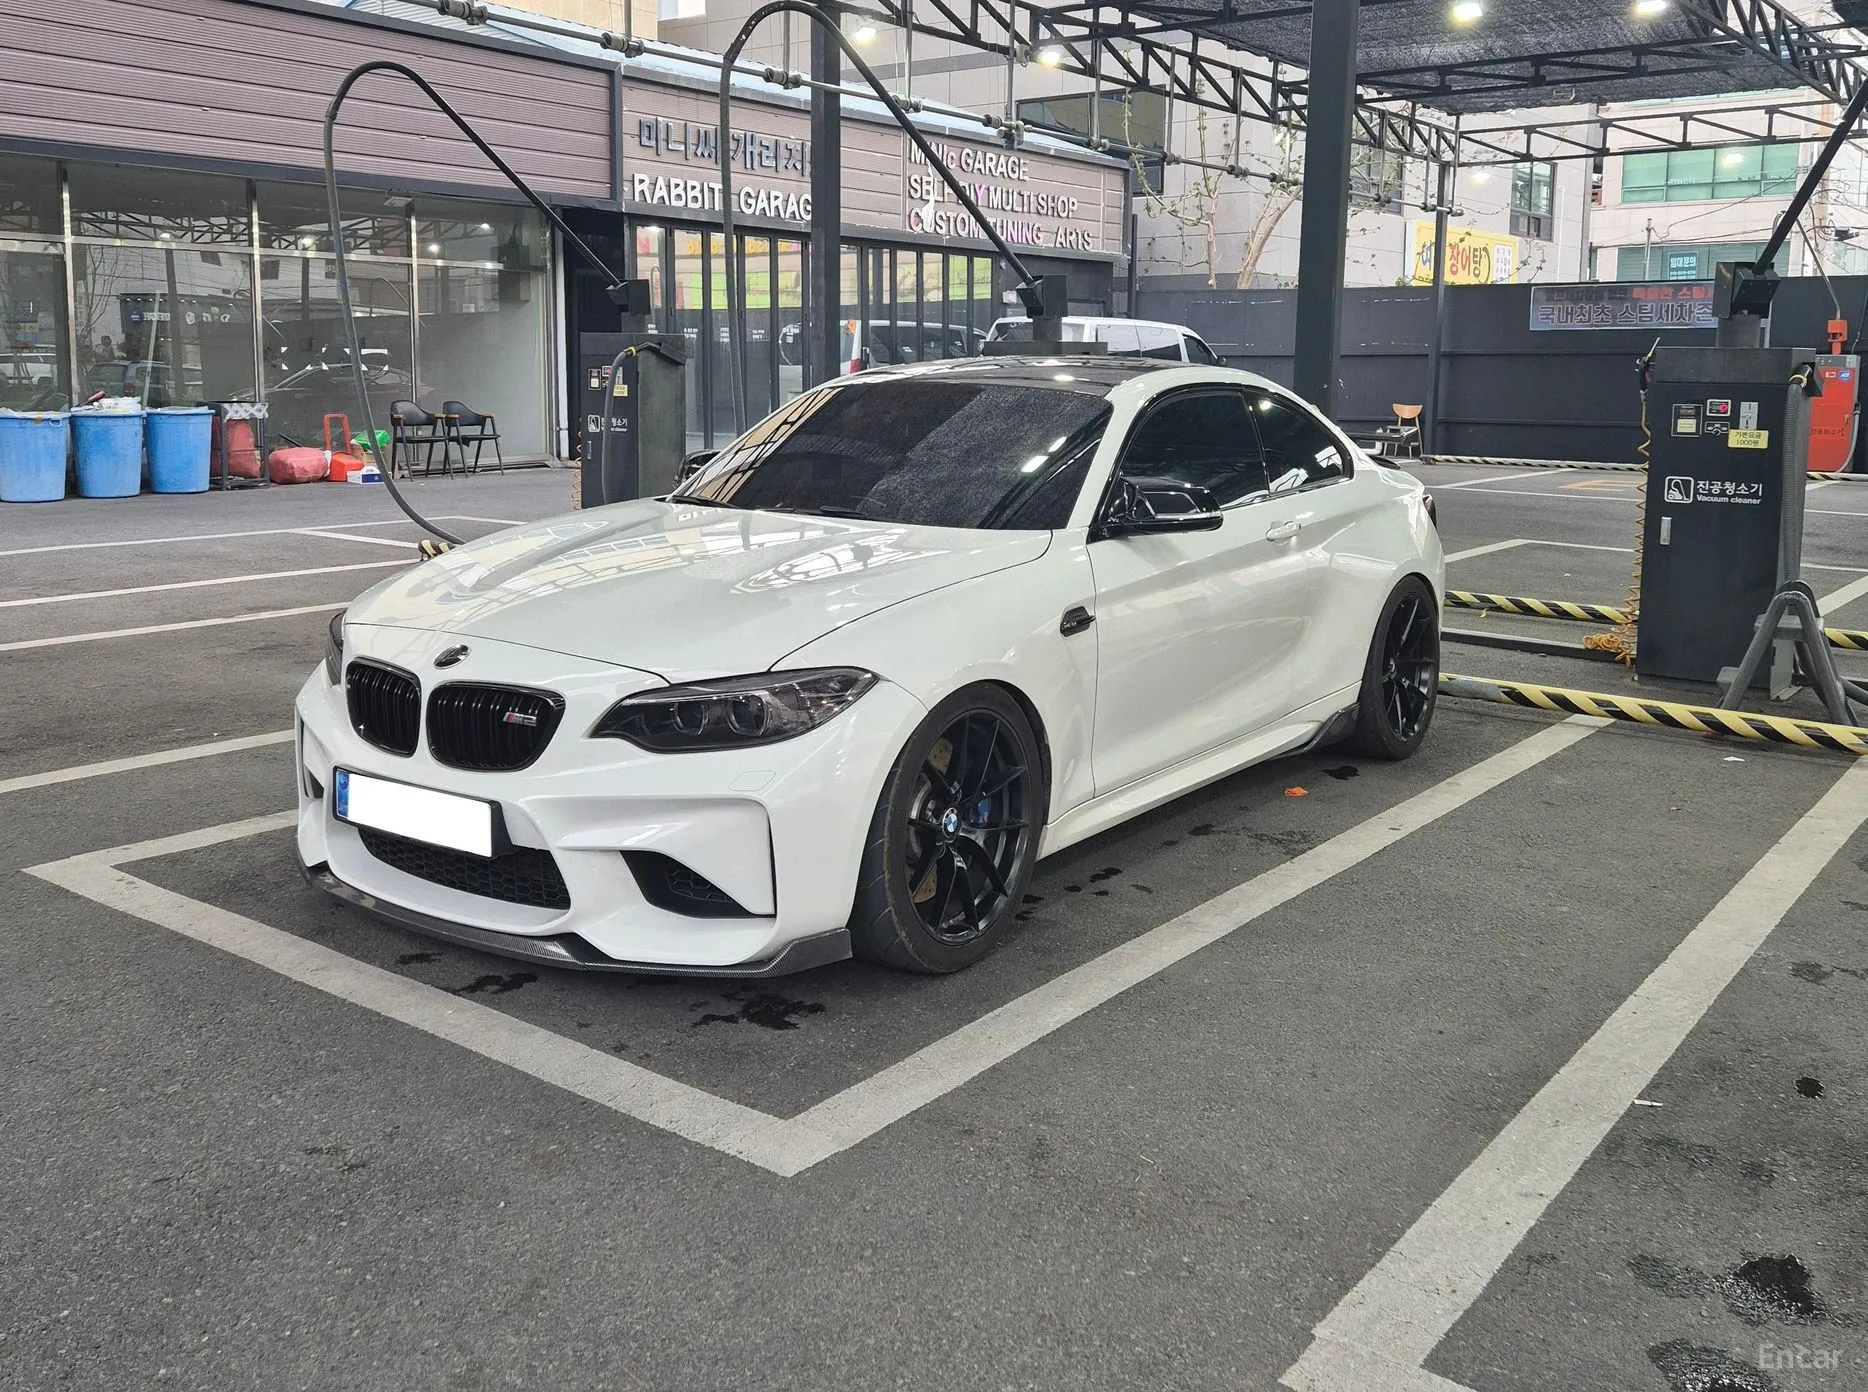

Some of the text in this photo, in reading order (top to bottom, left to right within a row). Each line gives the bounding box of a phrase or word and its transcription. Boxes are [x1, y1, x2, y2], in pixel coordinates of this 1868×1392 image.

[960, 147, 1029, 181] GARAGE
[633, 173, 723, 211] RABBIT
[988, 186, 1034, 213] MULTI
[1037, 192, 1079, 218] SHOP
[1055, 226, 1093, 250] ARTS
[1449, 242, 1482, 278] 장어탕
[1670, 256, 1697, 268] 임대문의
[1539, 303, 1612, 325] 국내최초
[1735, 431, 1762, 439] 기본요금
[1736, 439, 1760, 447] 1000원
[1696, 480, 1763, 497] 진공청소기
[1696, 494, 1762, 505] Vacuum cleaner
